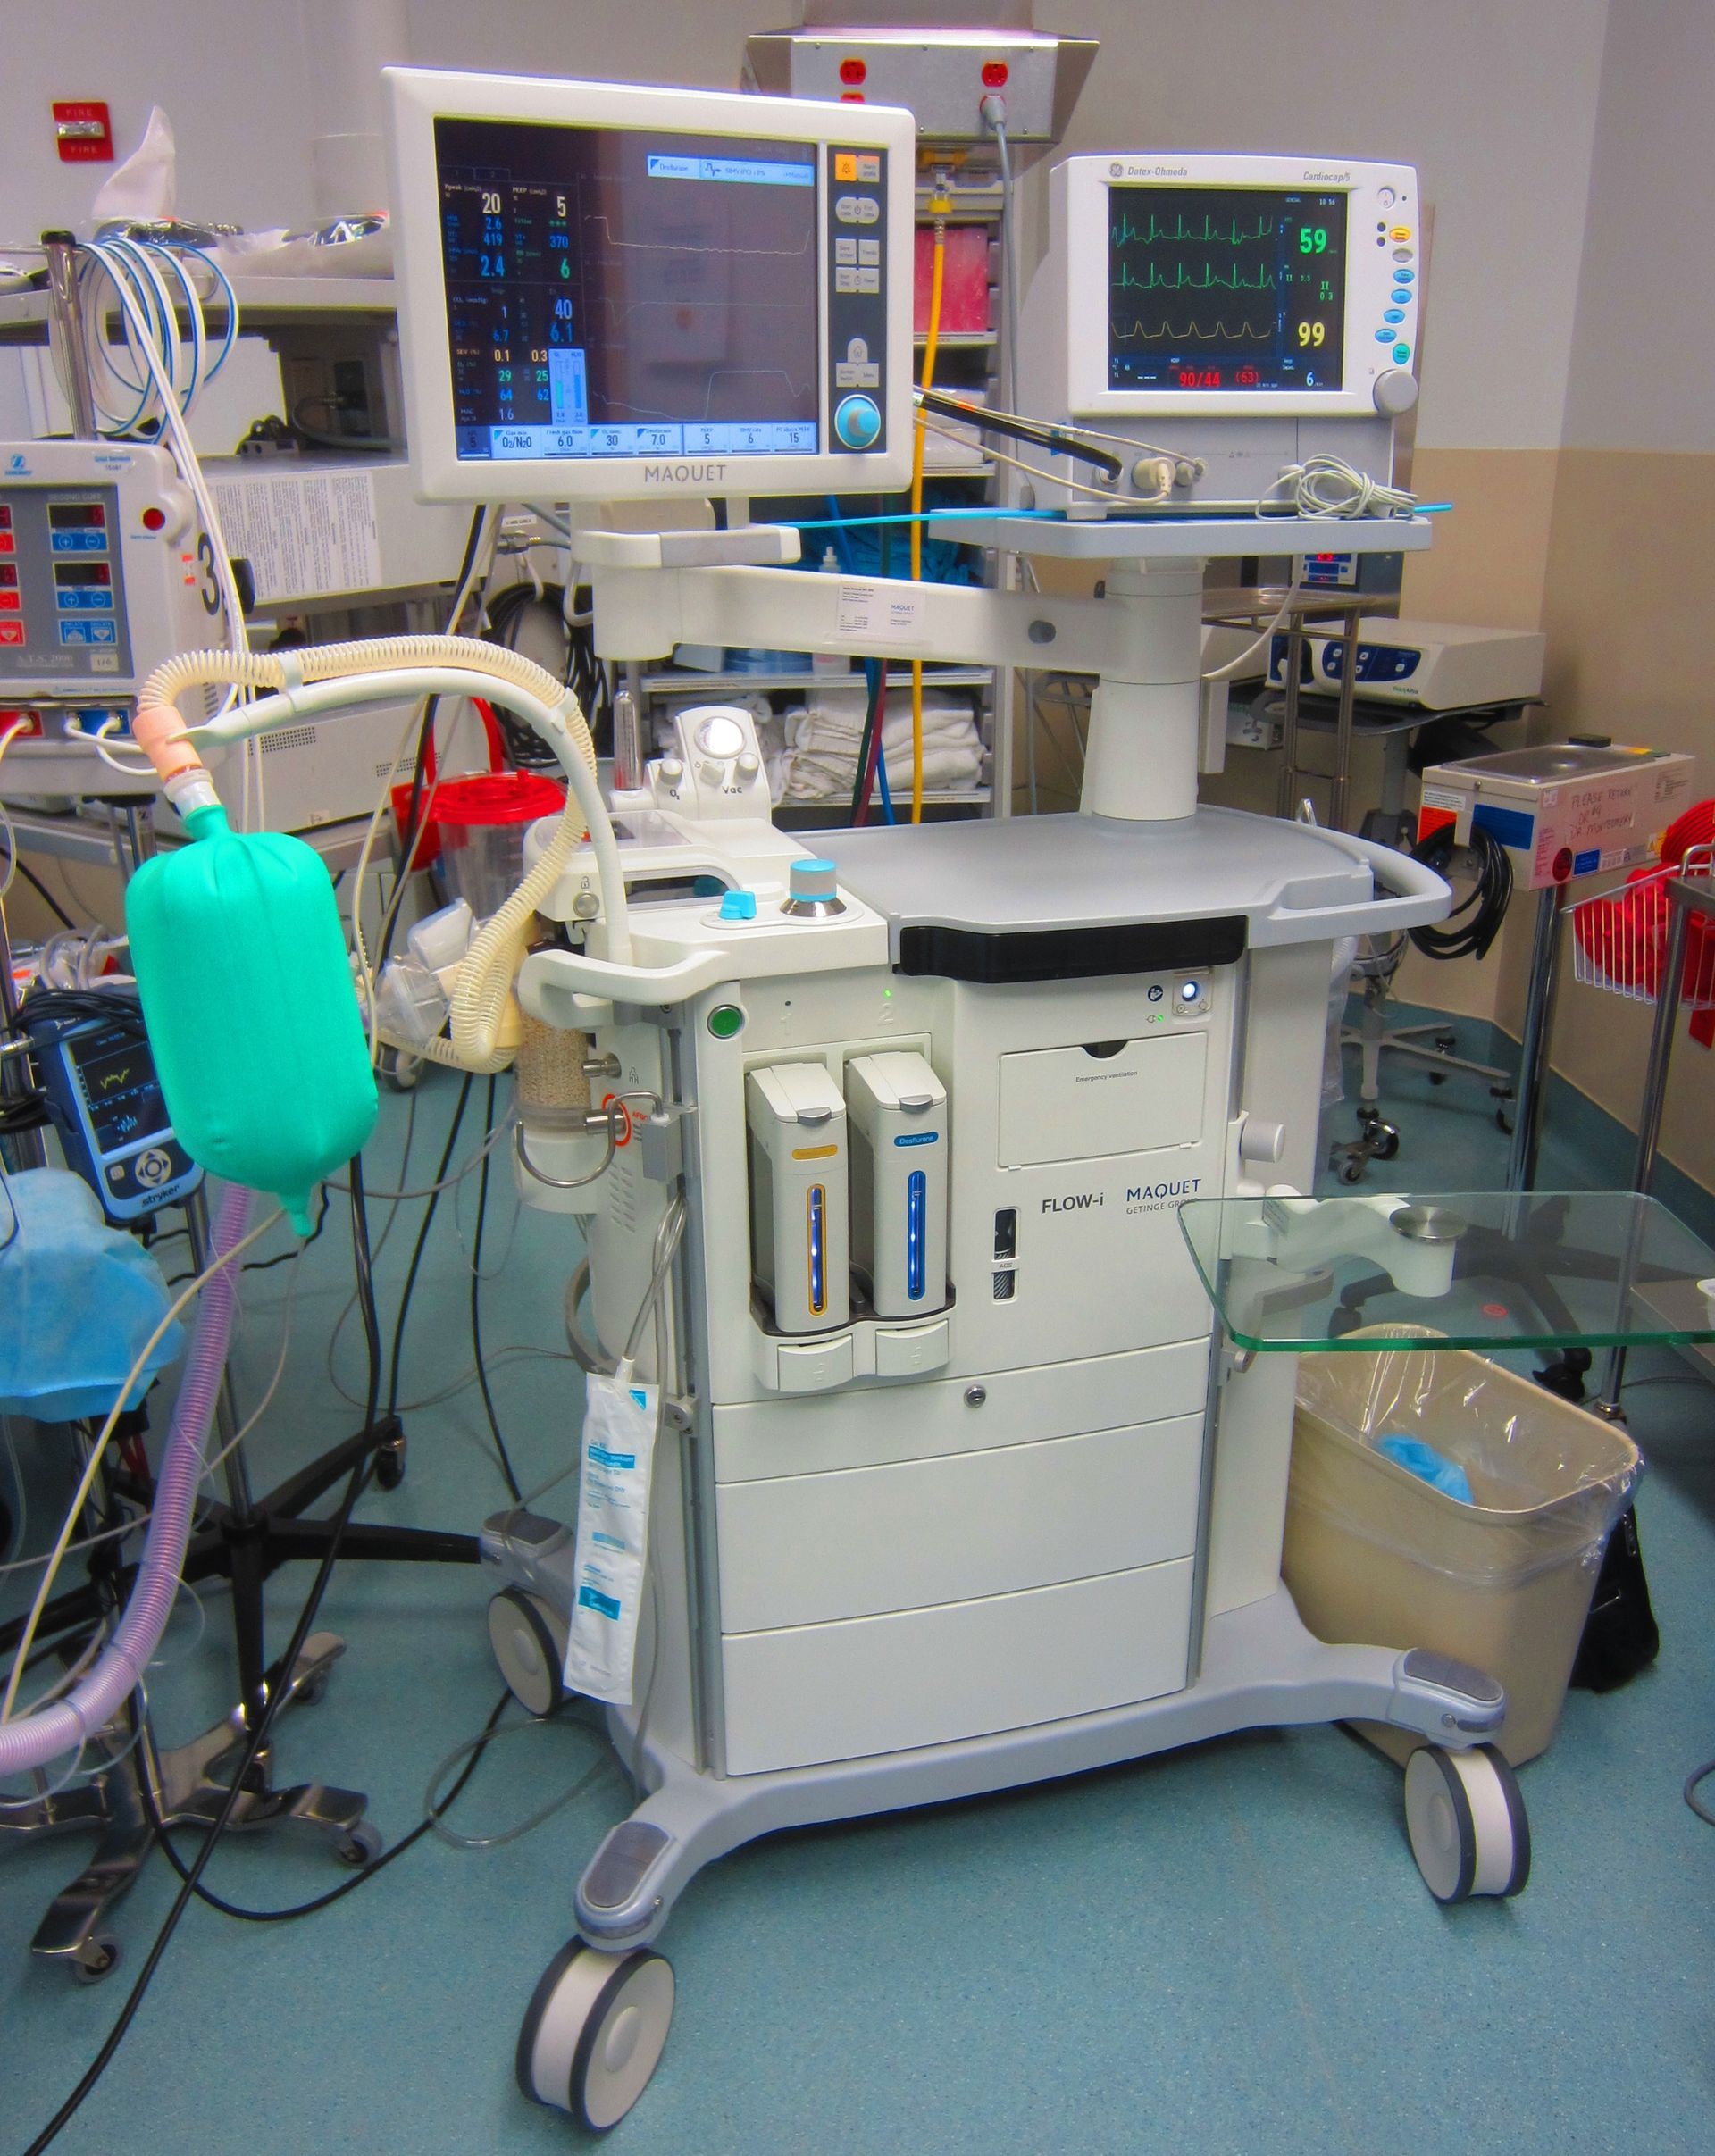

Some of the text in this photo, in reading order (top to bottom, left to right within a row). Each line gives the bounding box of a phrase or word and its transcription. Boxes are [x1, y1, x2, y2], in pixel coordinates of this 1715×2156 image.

[66, 108, 92, 117] FIRE
[71, 146, 97, 154] FIRE
[1128, 167, 1188, 177] Datex-Ohmeda
[1303, 171, 1351, 182] Cardiocap/5
[482, 192, 501, 214] 20
[556, 196, 566, 217] 5
[485, 217, 502, 230] 2.6
[483, 232, 503, 246] 419
[549, 235, 569, 249] 370
[1300, 227, 1327, 254] 59
[481, 255, 505, 277] 2.4
[560, 257, 570, 279] 6
[502, 305, 507, 319] 1
[554, 298, 573, 320] 40
[493, 329, 509, 343] 6.7
[549, 322, 573, 343] 6.1
[1298, 322, 1325, 347] 99
[494, 348, 510, 362] 0.1
[531, 348, 548, 362] 0.3
[498, 369, 512, 382] 29
[536, 369, 548, 382] 25
[1180, 372, 1220, 387] 90/44
[1235, 371, 1259, 384] (63)
[1306, 372, 1314, 387] 6
[500, 389, 513, 401] 64
[537, 389, 549, 401] 62
[499, 407, 514, 421] 1.6
[557, 435, 573, 447] 6.0
[607, 434, 618, 446] 30
[651, 433, 665, 445] 7.0
[704, 433, 710, 445] 5
[748, 432, 754, 444] 6
[790, 432, 799, 444] 15
[644, 464, 727, 483] MAQUET
[197, 532, 220, 616] 3
[670, 789, 680, 800] O2
[722, 786, 742, 794] Vac
[1571, 791, 1603, 808] PLEASE
[1075, 1071, 1138, 1083] Emergency ventilation
[899, 1134, 934, 1145] Desflurane
[142, 1184, 180, 1206] stryker
[1126, 1178, 1202, 1202] MAQUET
[1042, 1192, 1104, 1214] FLOW-i
[1126, 1201, 1166, 1215] GETINGE
